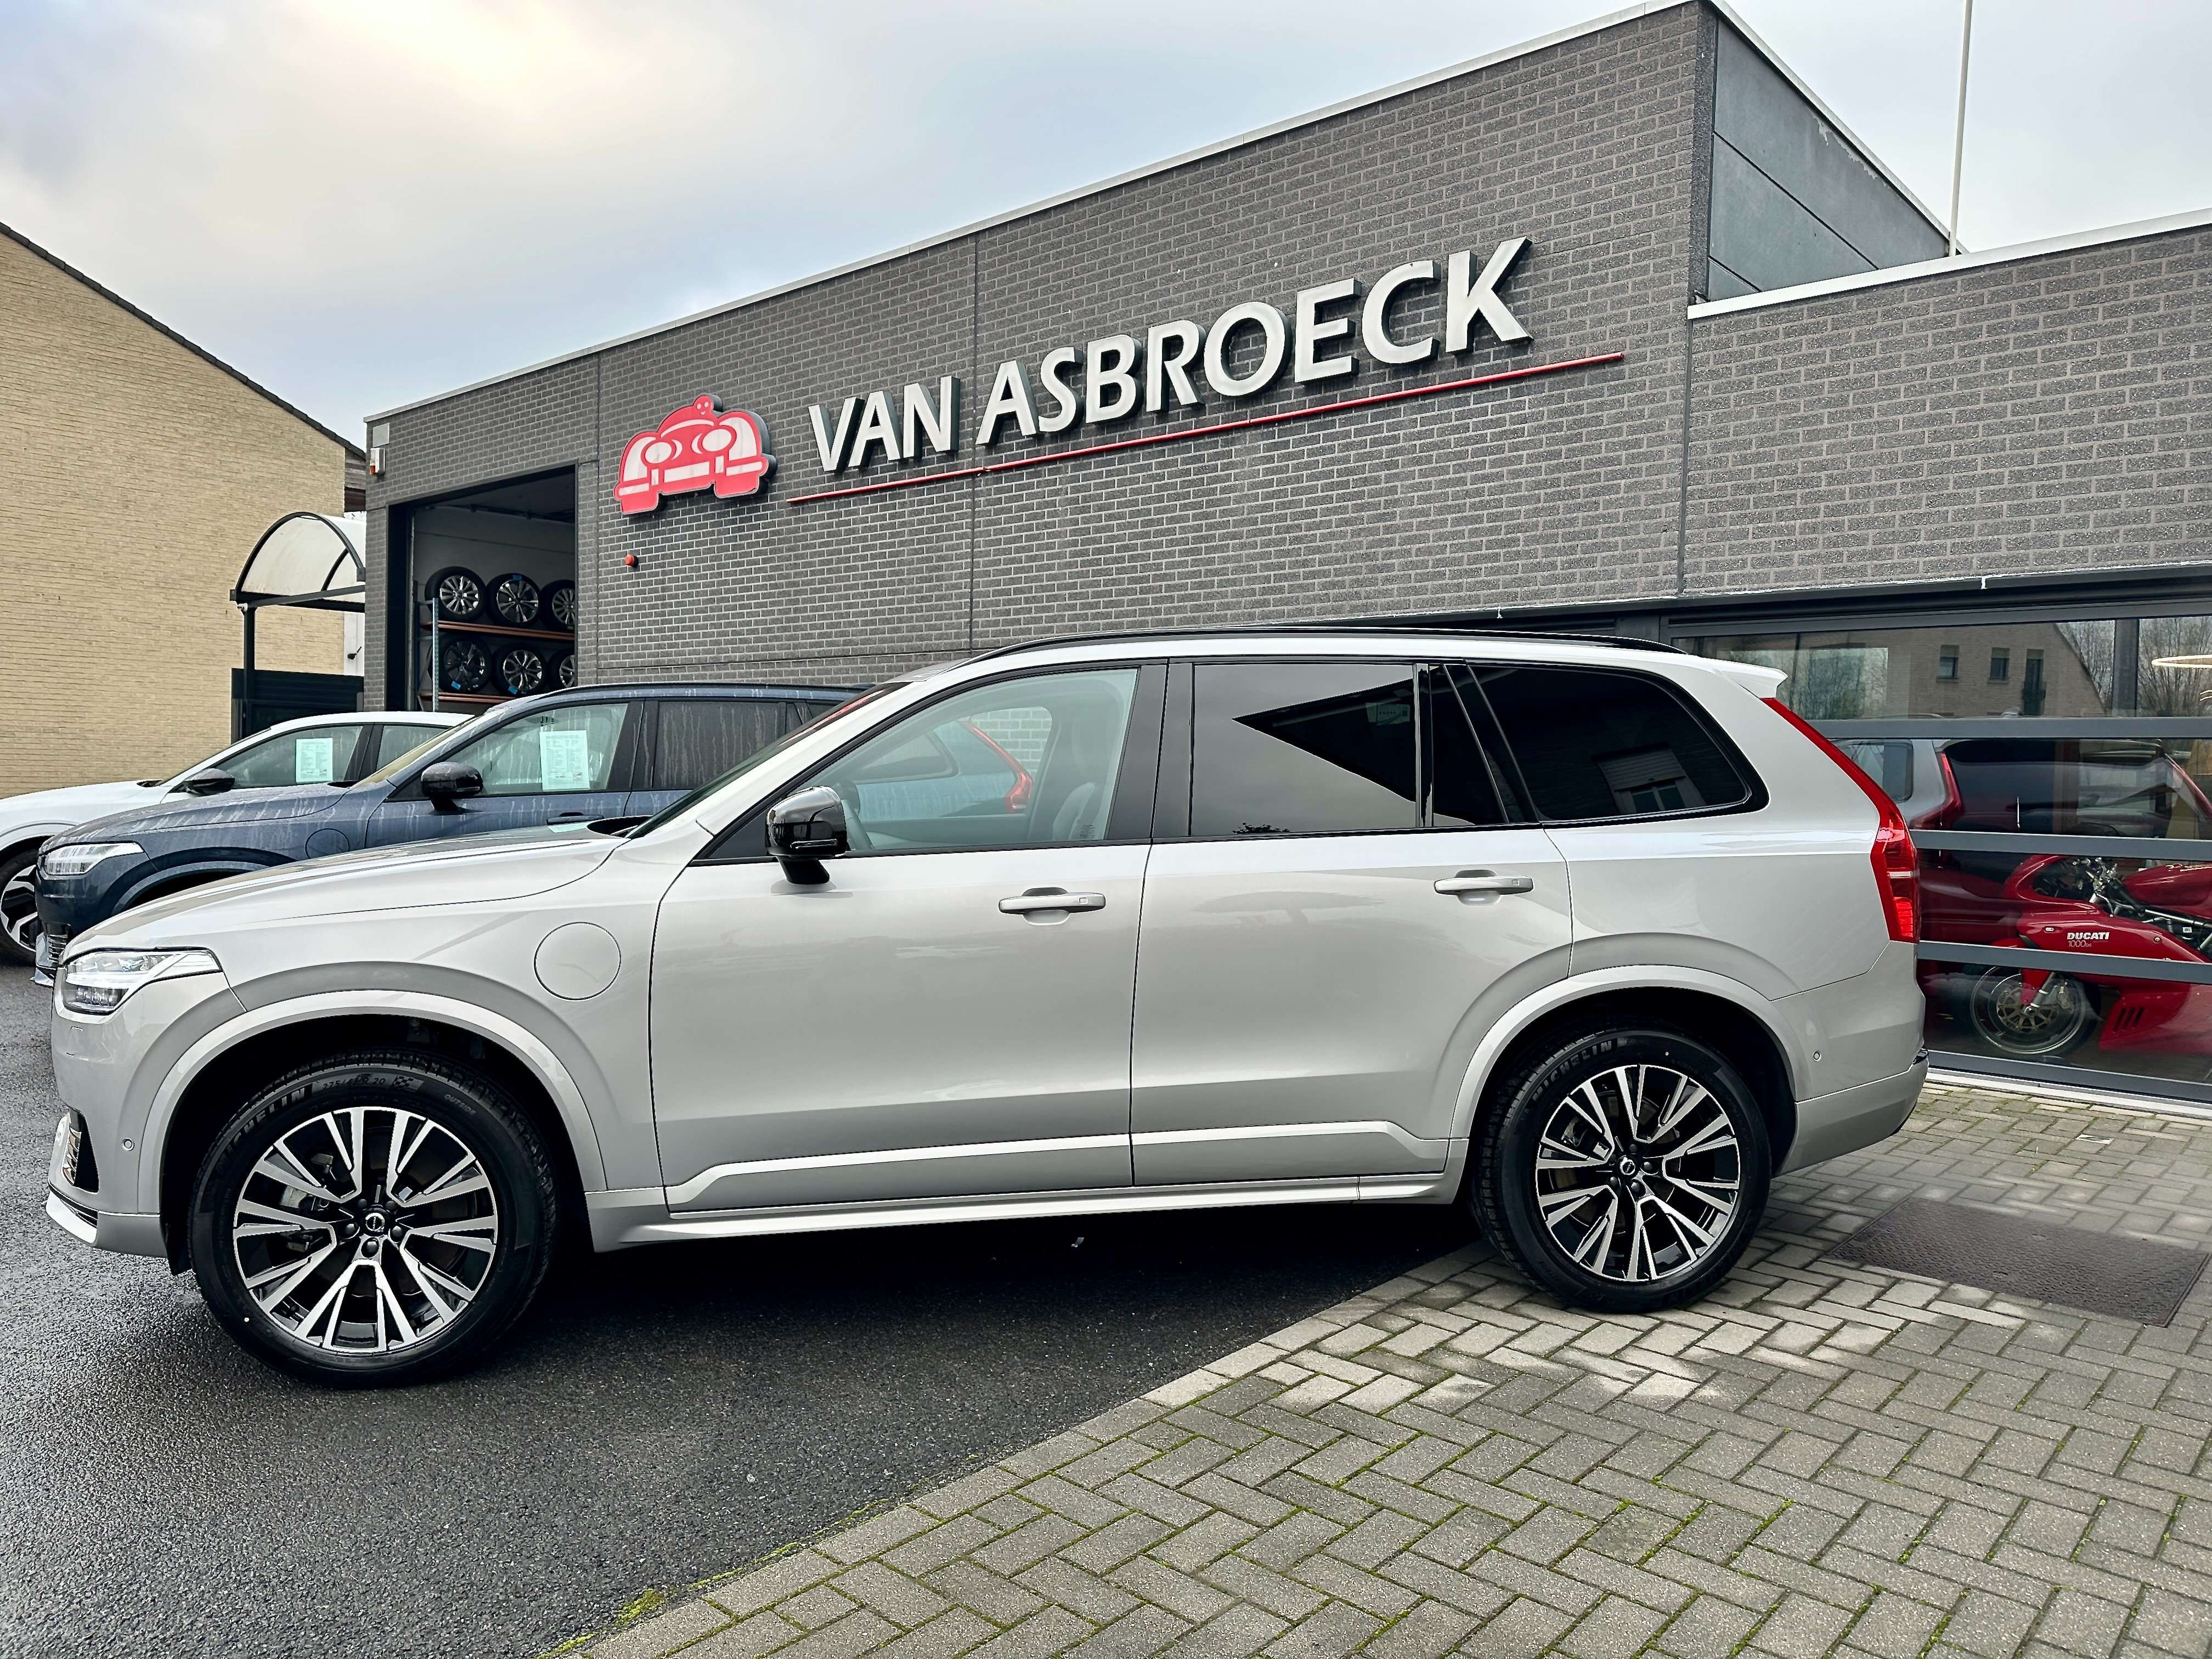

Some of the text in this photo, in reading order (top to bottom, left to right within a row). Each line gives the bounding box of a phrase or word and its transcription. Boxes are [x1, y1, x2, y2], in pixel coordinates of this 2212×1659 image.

[808, 235, 1533, 472] VAN ASBROECK
[1532, 1040, 1612, 1102] MICHELIN
[444, 1094, 477, 1115] OUTSIDE
